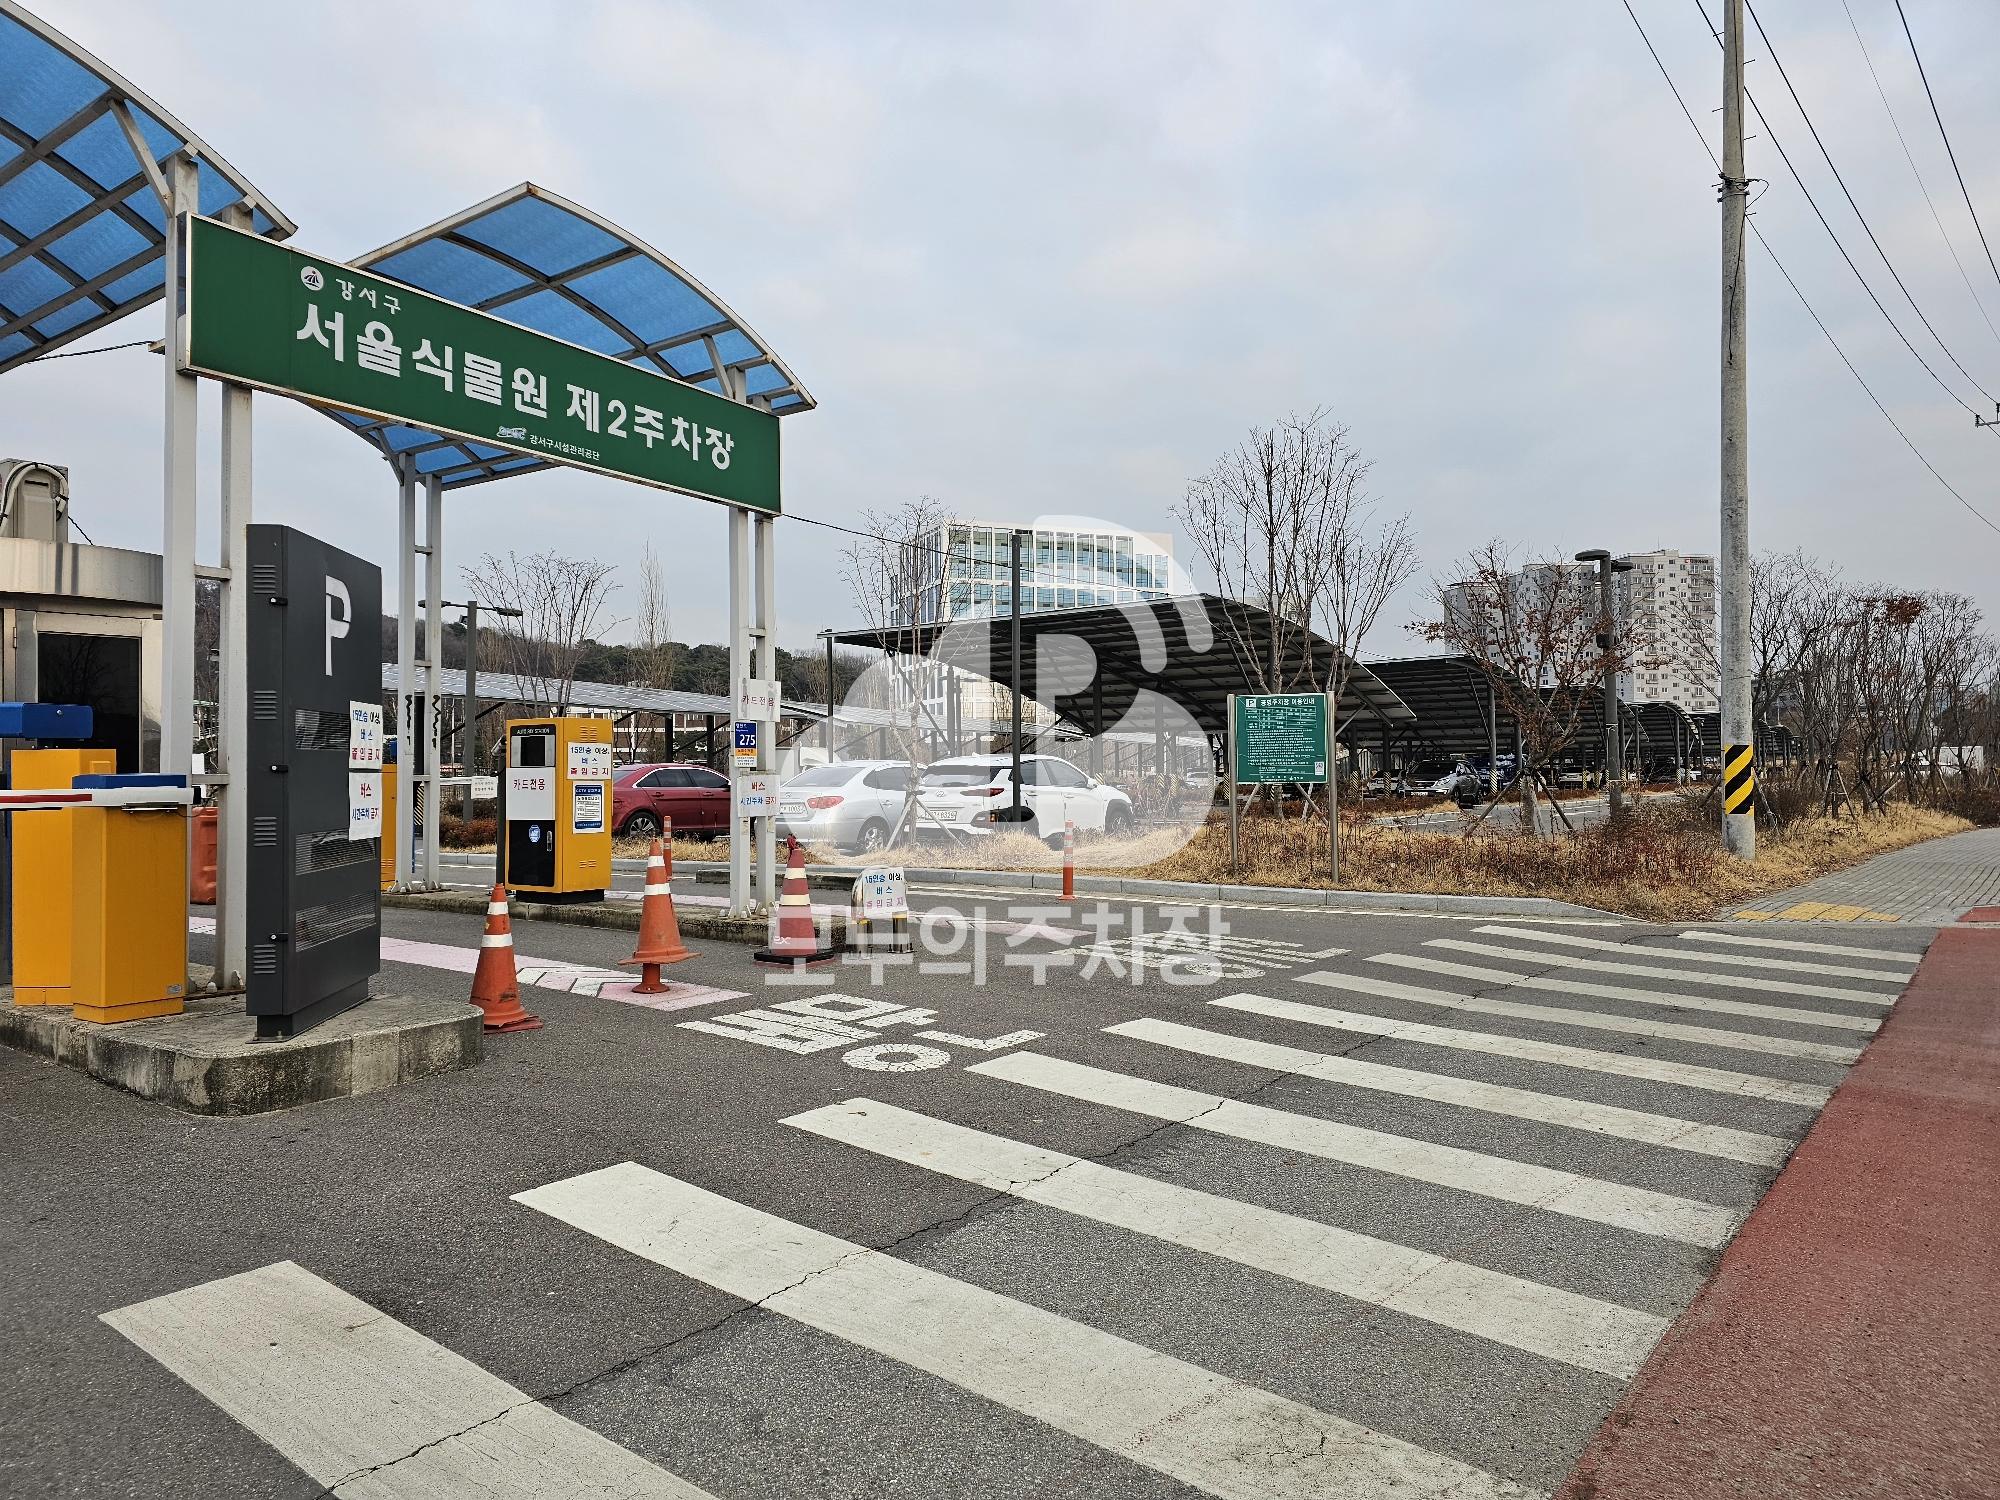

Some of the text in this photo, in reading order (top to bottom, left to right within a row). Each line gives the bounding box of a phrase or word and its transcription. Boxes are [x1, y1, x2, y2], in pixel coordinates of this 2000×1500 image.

[335, 278, 401, 314] 강서구
[296, 303, 735, 470] 서울식물원 제2주차장
[529, 434, 600, 461] 강서구시설관리공단
[325, 574, 352, 677] P
[741, 694, 775, 707] 카드전용
[739, 734, 756, 746] 275
[570, 746, 592, 755] 15인승
[513, 778, 545, 791] 카드전용
[751, 781, 766, 791] 버스
[765, 796, 777, 805] 금지
[865, 874, 886, 884] 15인승
[876, 886, 893, 895] 버스
[673, 993, 1049, 1073] 방문
